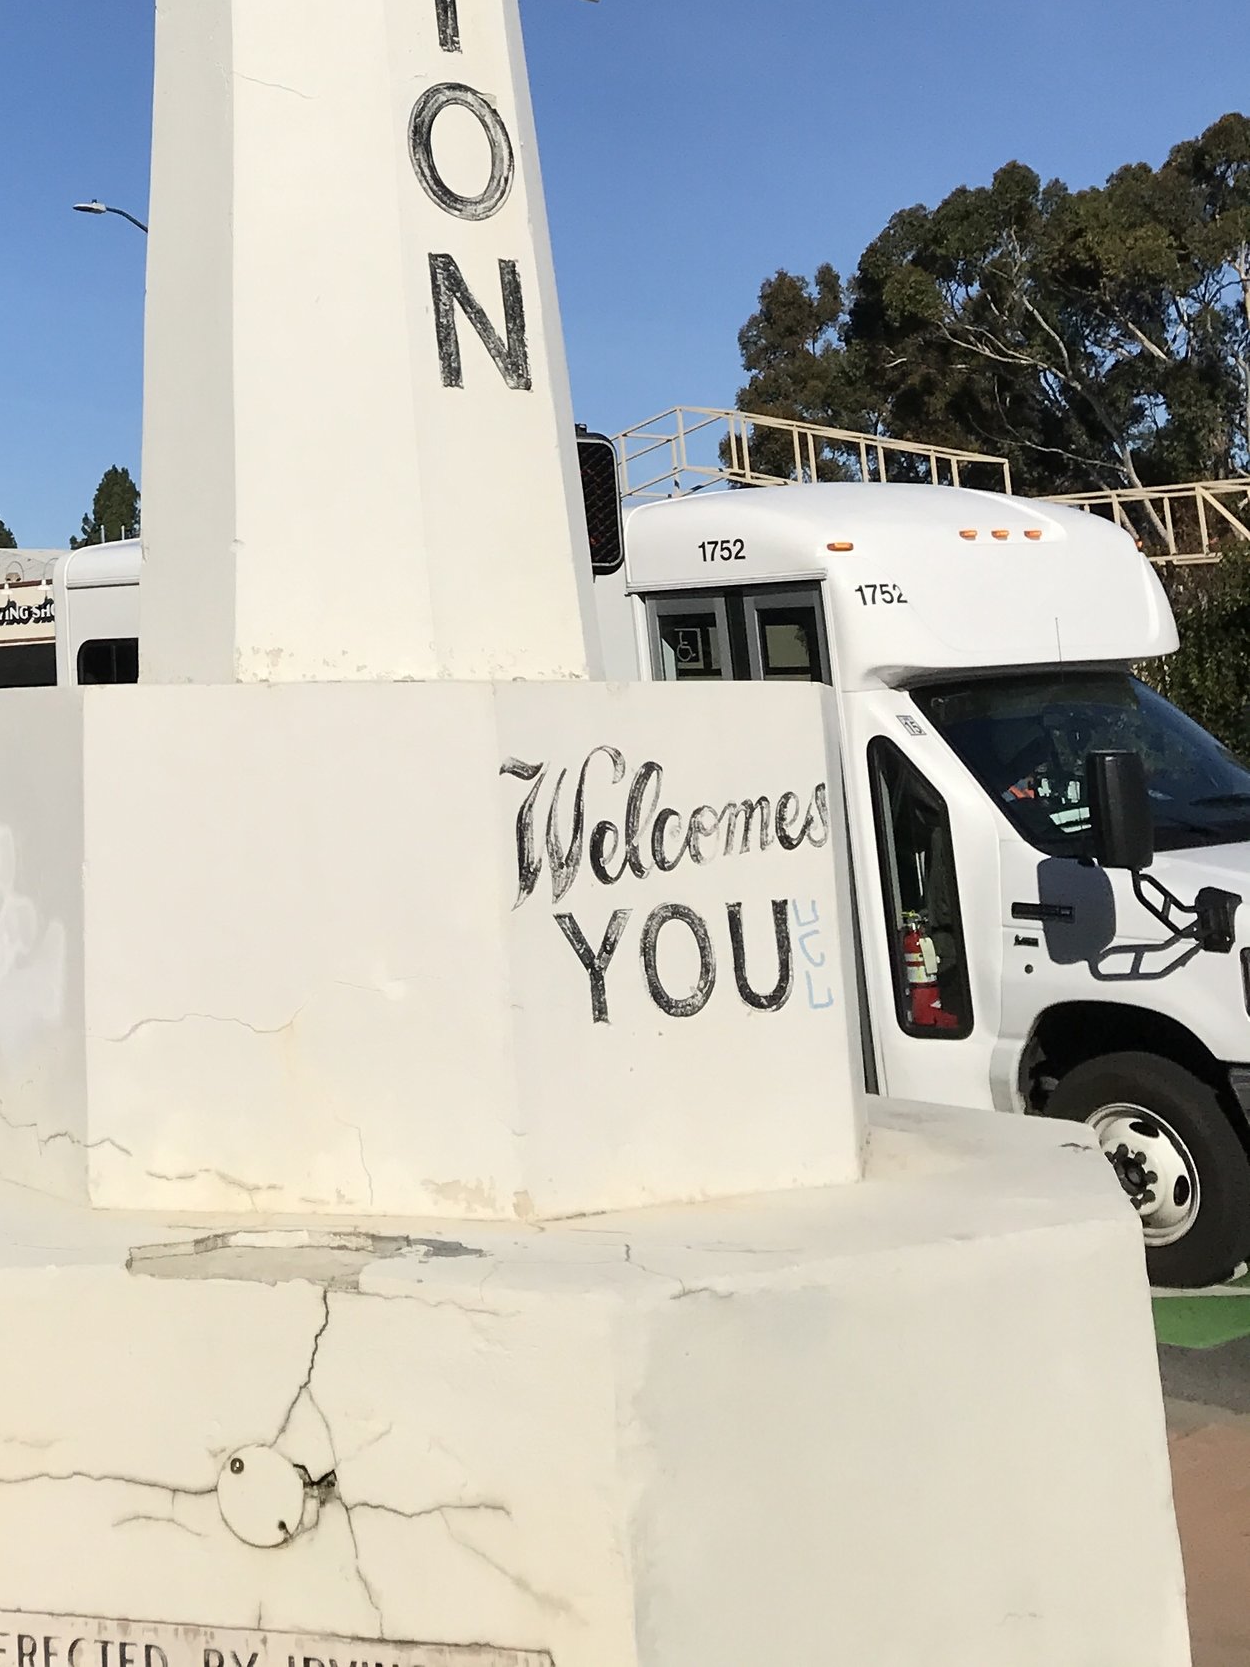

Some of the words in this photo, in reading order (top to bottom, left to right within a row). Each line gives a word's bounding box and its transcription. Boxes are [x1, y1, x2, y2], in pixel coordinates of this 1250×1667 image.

[698, 538, 746, 562] 1752
[855, 584, 908, 605] 1752
[499, 745, 828, 911] Welcomes
[552, 899, 794, 1024] YOU
